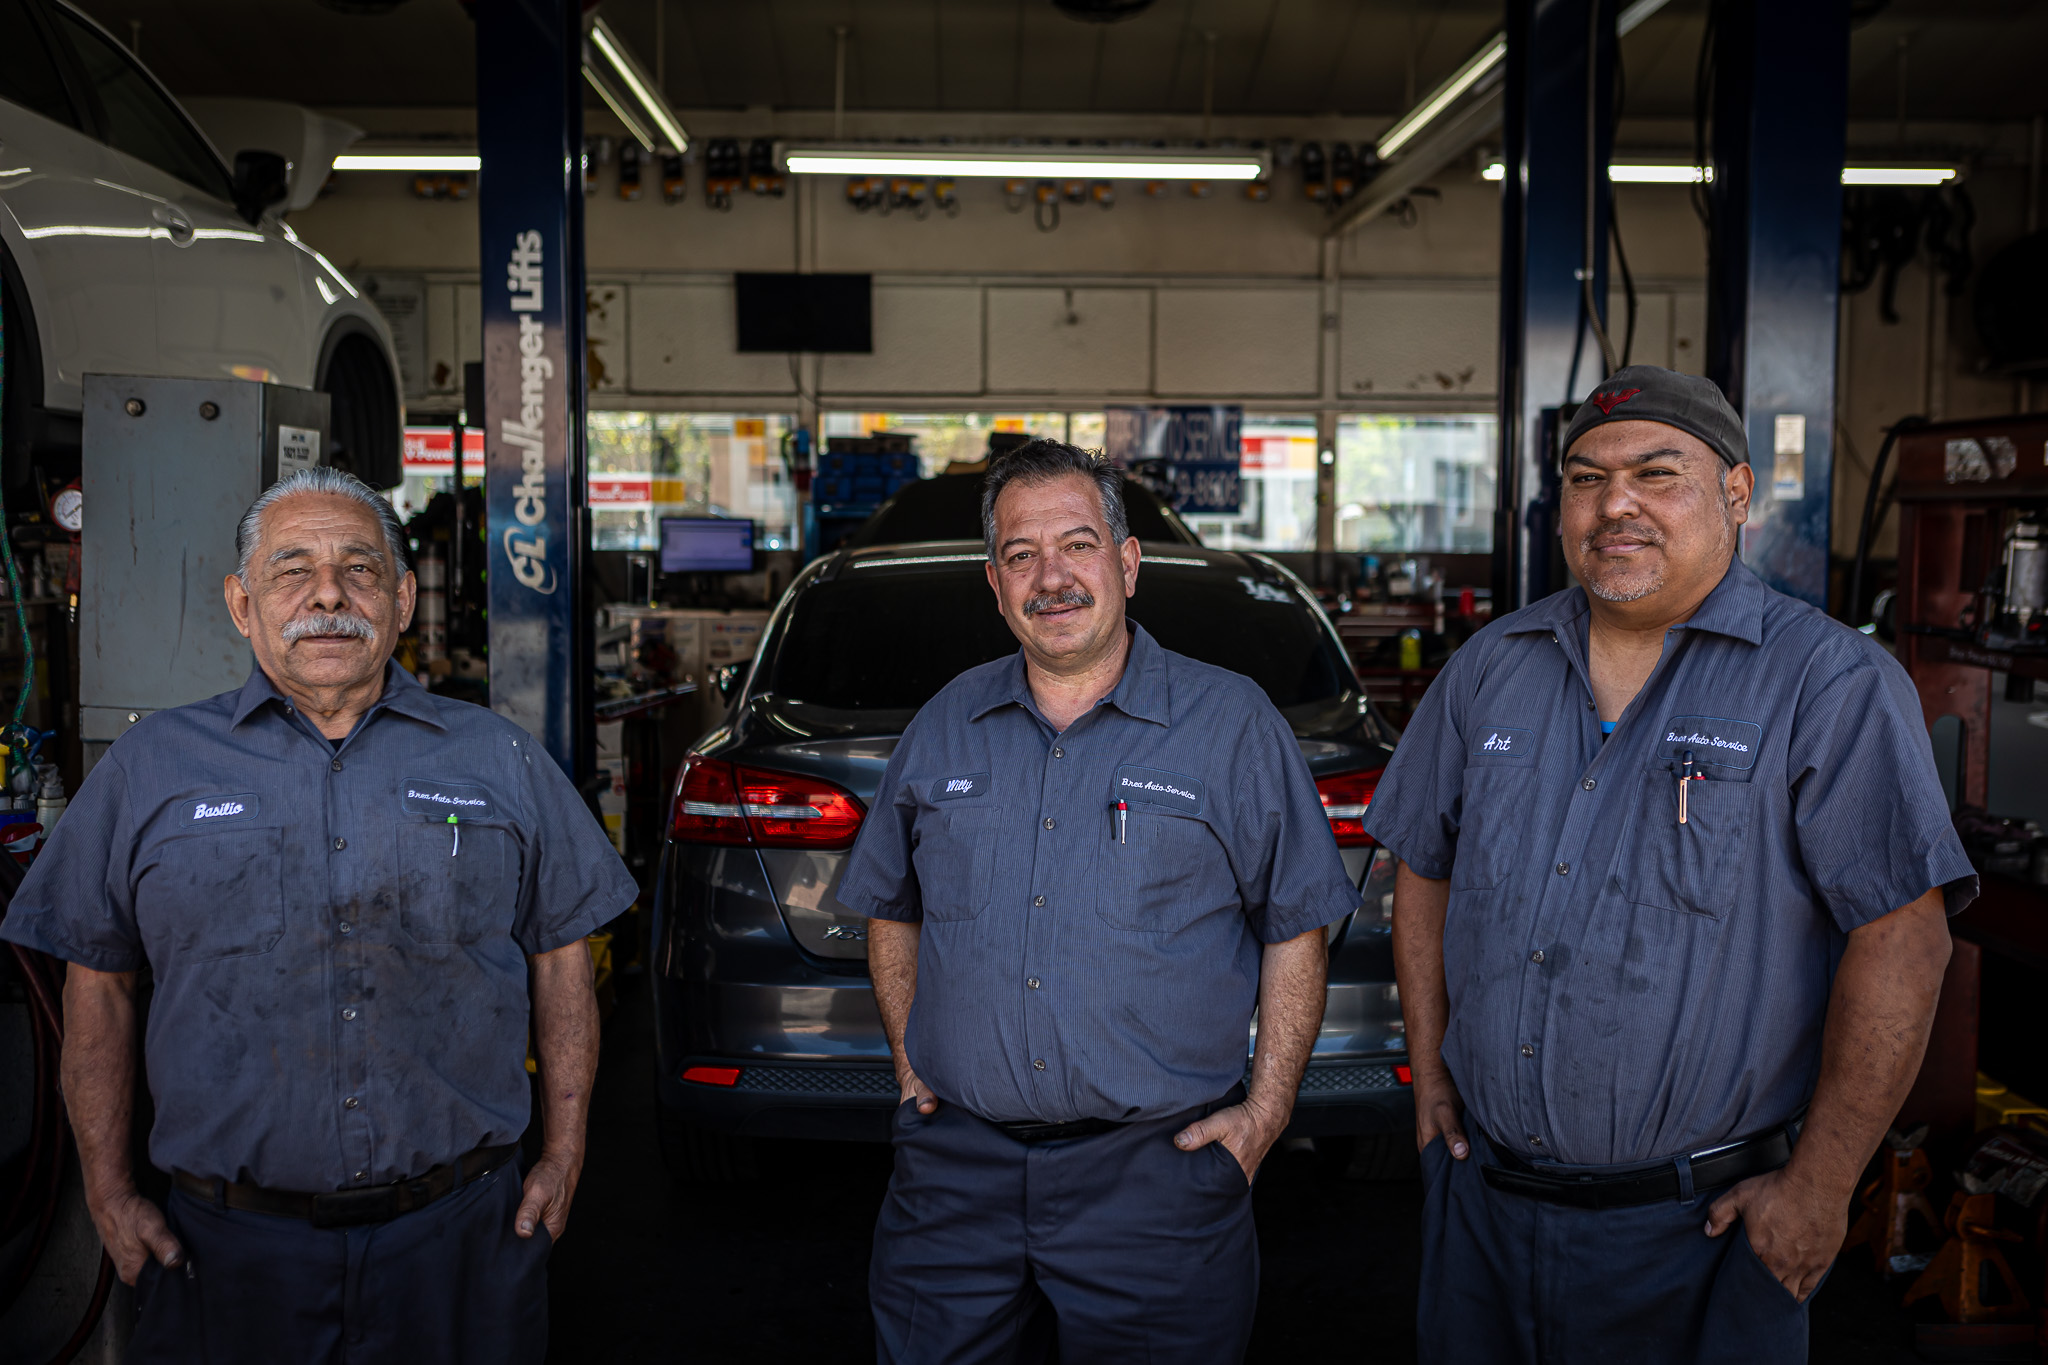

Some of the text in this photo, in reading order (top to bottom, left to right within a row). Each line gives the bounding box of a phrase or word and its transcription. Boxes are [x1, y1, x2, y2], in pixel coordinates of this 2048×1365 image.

[507, 229, 544, 312] Lifts
[502, 314, 554, 527] Challenger
[1483, 732, 1512, 751] Art
[1687, 732, 1710, 745] Auto
[1711, 736, 1748, 752] Service
[945, 778, 973, 793] Willy
[1121, 777, 1196, 801] Brea Auto Service
[407, 789, 487, 807] Brea Auto Service
[193, 802, 245, 820] Basilio
